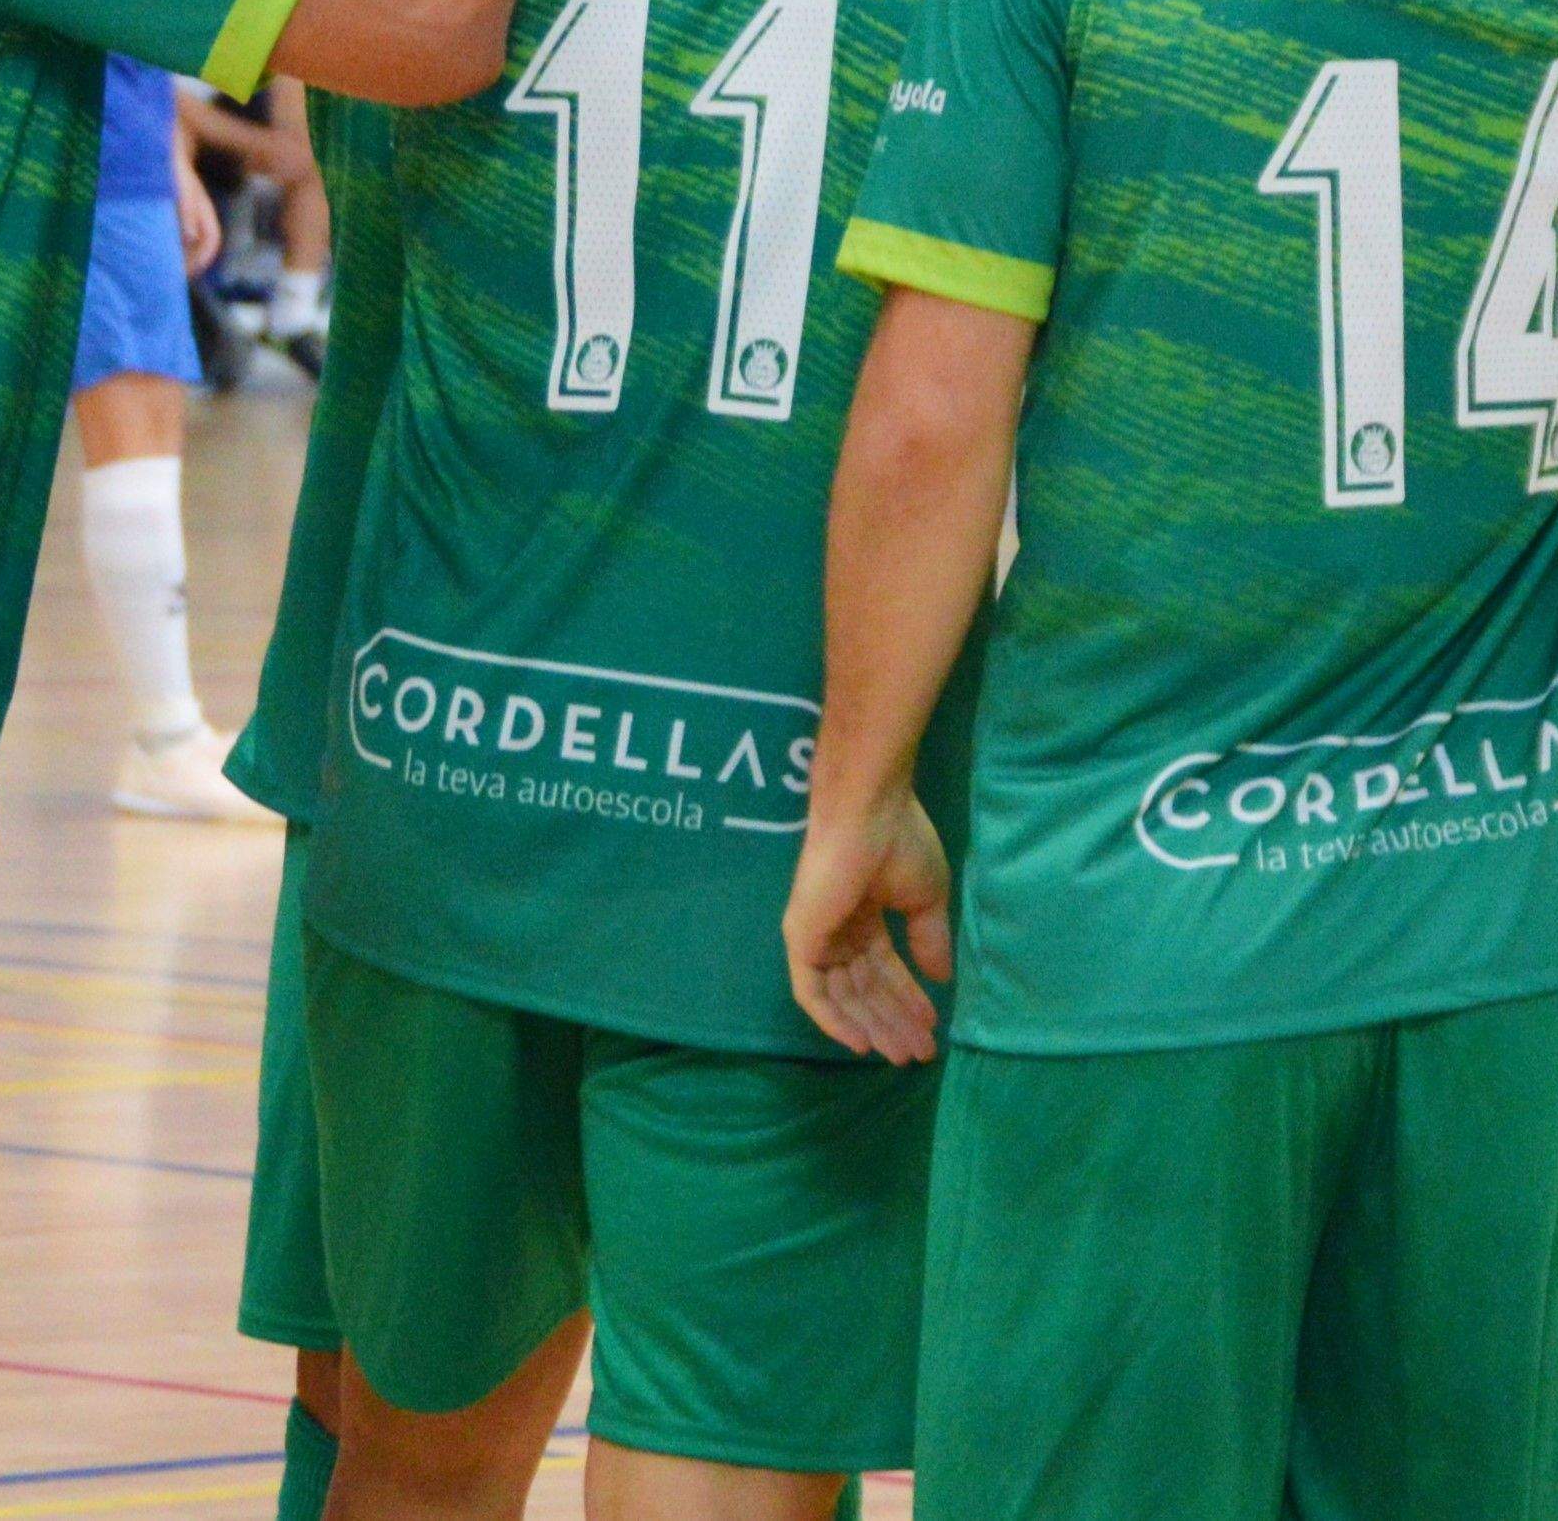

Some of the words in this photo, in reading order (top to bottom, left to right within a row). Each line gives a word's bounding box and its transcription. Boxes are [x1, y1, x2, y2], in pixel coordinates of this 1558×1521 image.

[358, 662, 816, 795] CORDELLAS
[403, 748, 427, 787] la
[437, 760, 506, 800] teva
[518, 776, 705, 832] autoescola
[1254, 837, 1288, 873] la
[1369, 799, 1549, 856] autoescola
